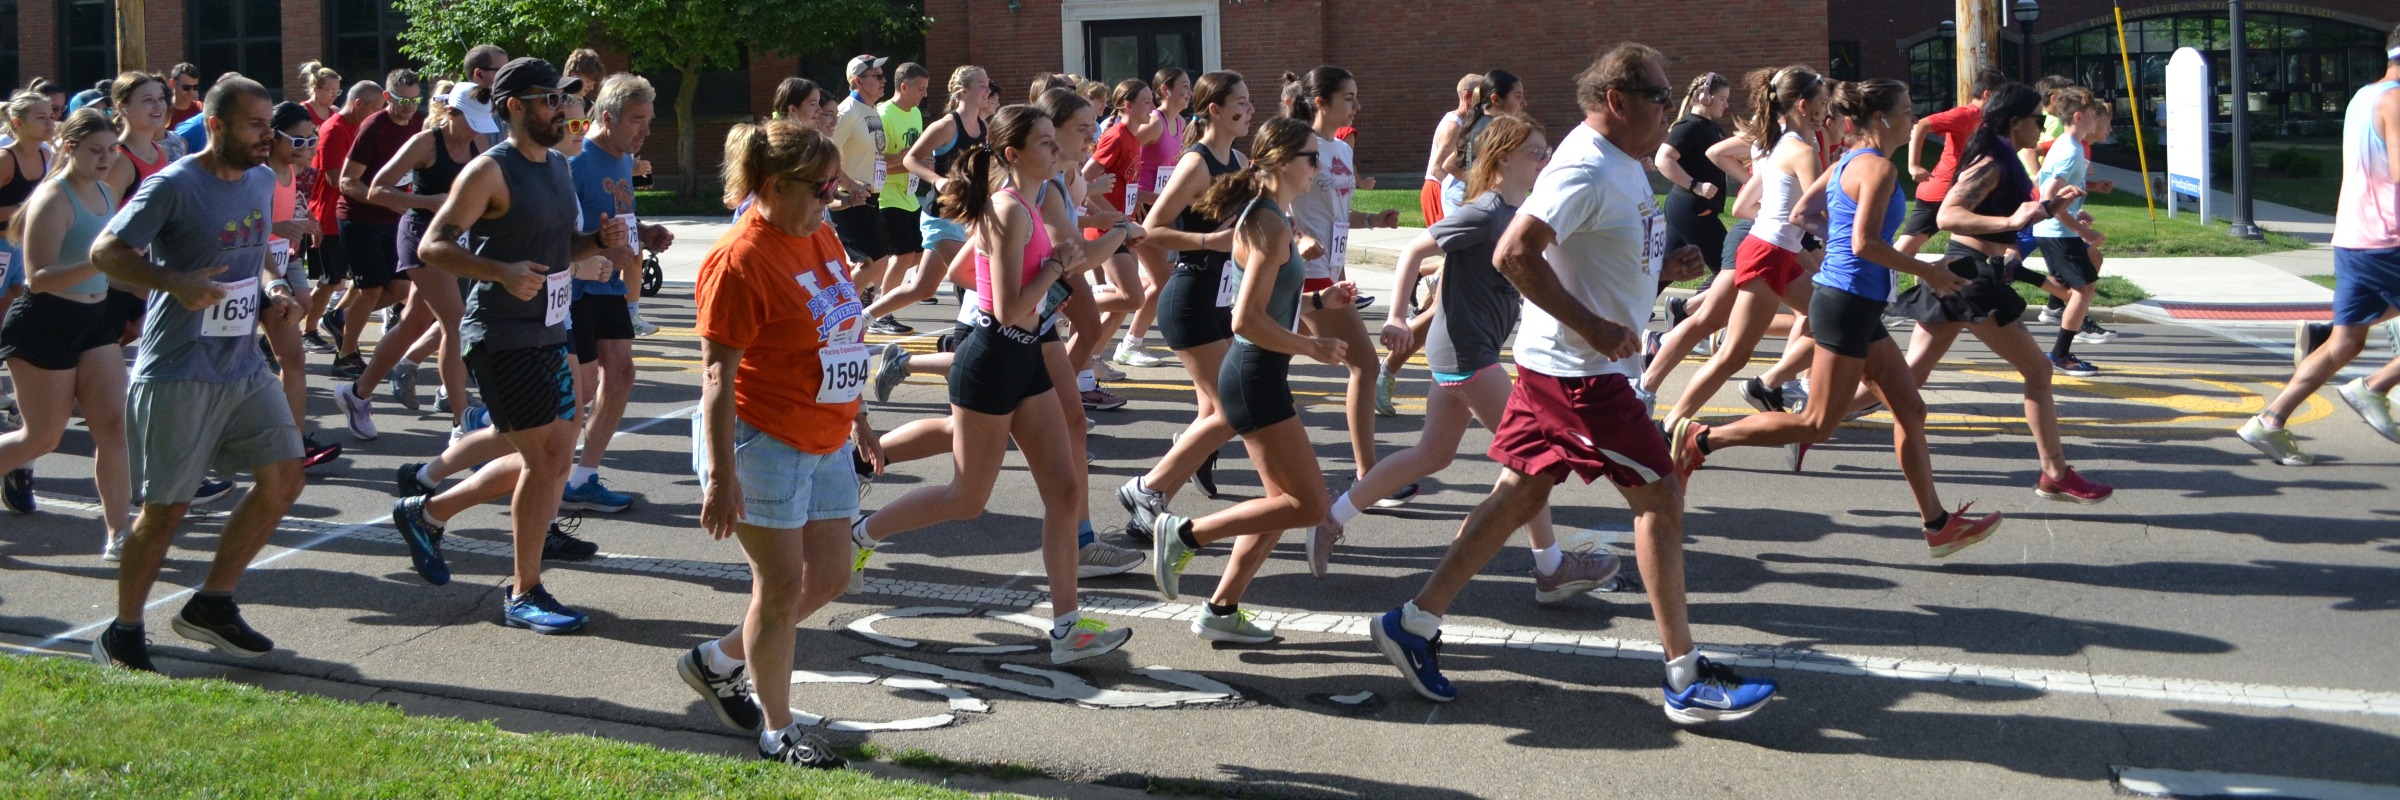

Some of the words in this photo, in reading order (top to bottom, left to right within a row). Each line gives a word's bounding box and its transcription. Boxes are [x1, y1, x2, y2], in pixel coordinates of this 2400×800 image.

[2122, 3, 2178, 19] PANGLER
[2257, 1, 2337, 18] COURTYARD
[273, 250, 287, 267] 701
[1650, 231, 1665, 260] 159
[212, 294, 255, 320] 1634
[550, 284, 569, 311] 169
[807, 282, 858, 320] RESPEC
[825, 303, 862, 328] UNIVERSIT
[997, 325, 1034, 345] NIKE
[826, 359, 868, 391] 1594
